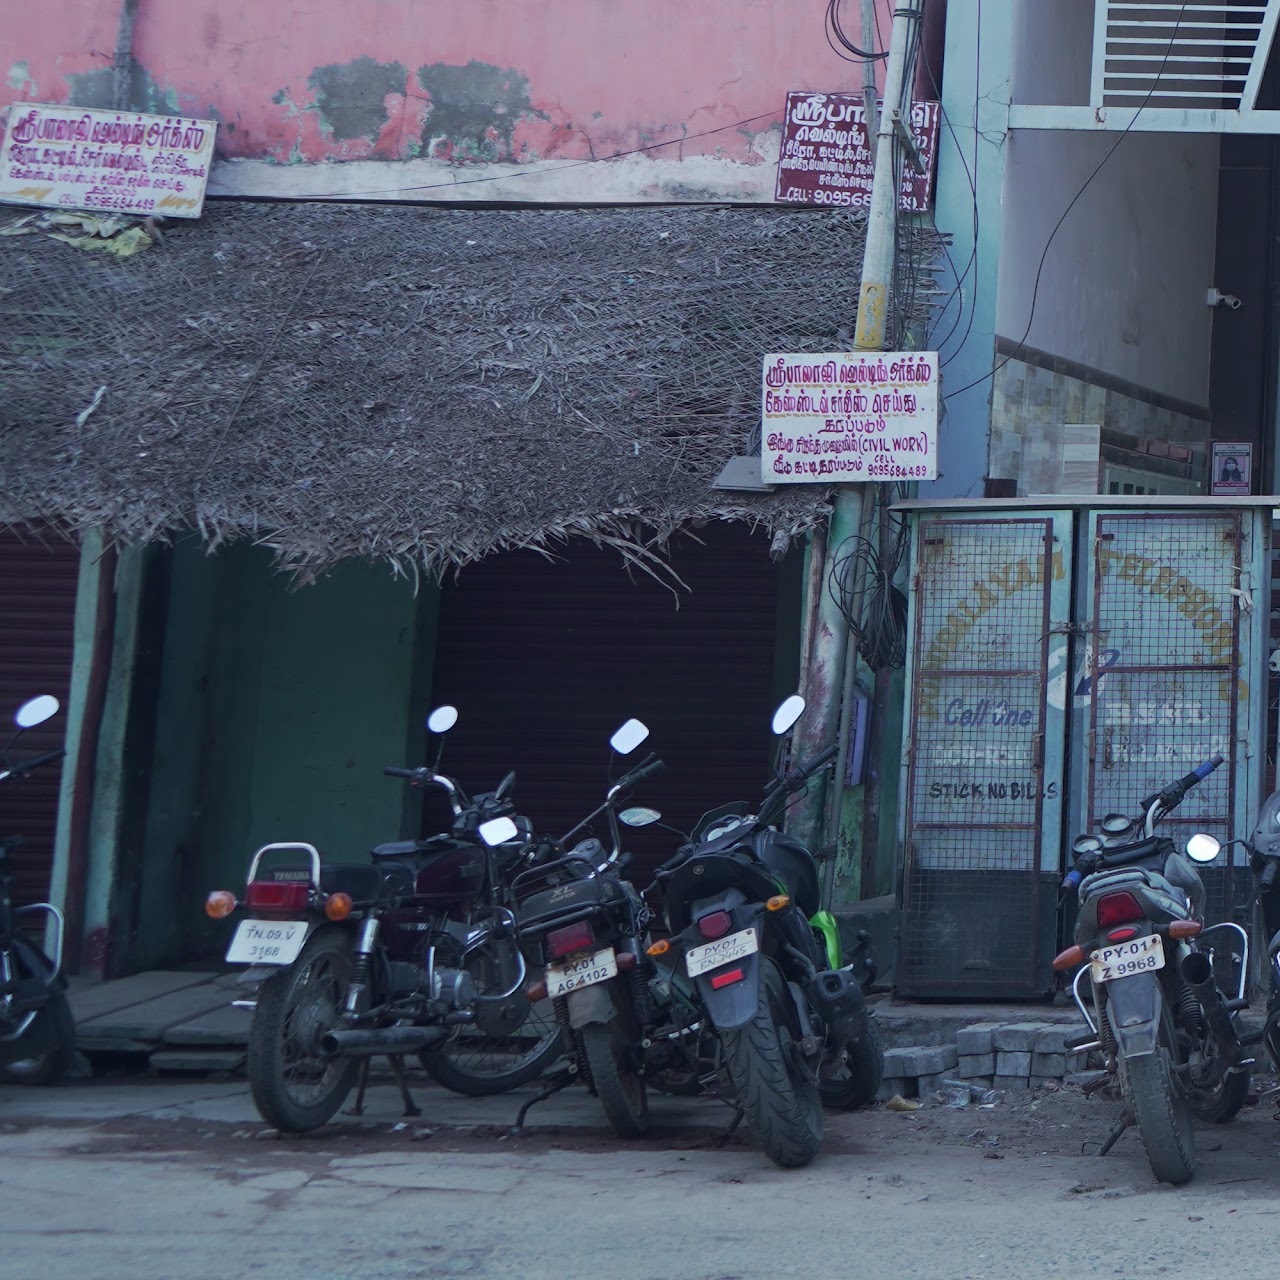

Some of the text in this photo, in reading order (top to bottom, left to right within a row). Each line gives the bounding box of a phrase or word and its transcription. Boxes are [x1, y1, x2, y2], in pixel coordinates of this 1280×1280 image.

[859, 434, 891, 455] (CIVIL
[892, 431, 928, 456] WORK)
[874, 454, 895, 464] CELL
[867, 464, 927, 478] 9095684489
[1103, 940, 1148, 962] PY-01
[1102, 956, 1157, 980] Z 9968
